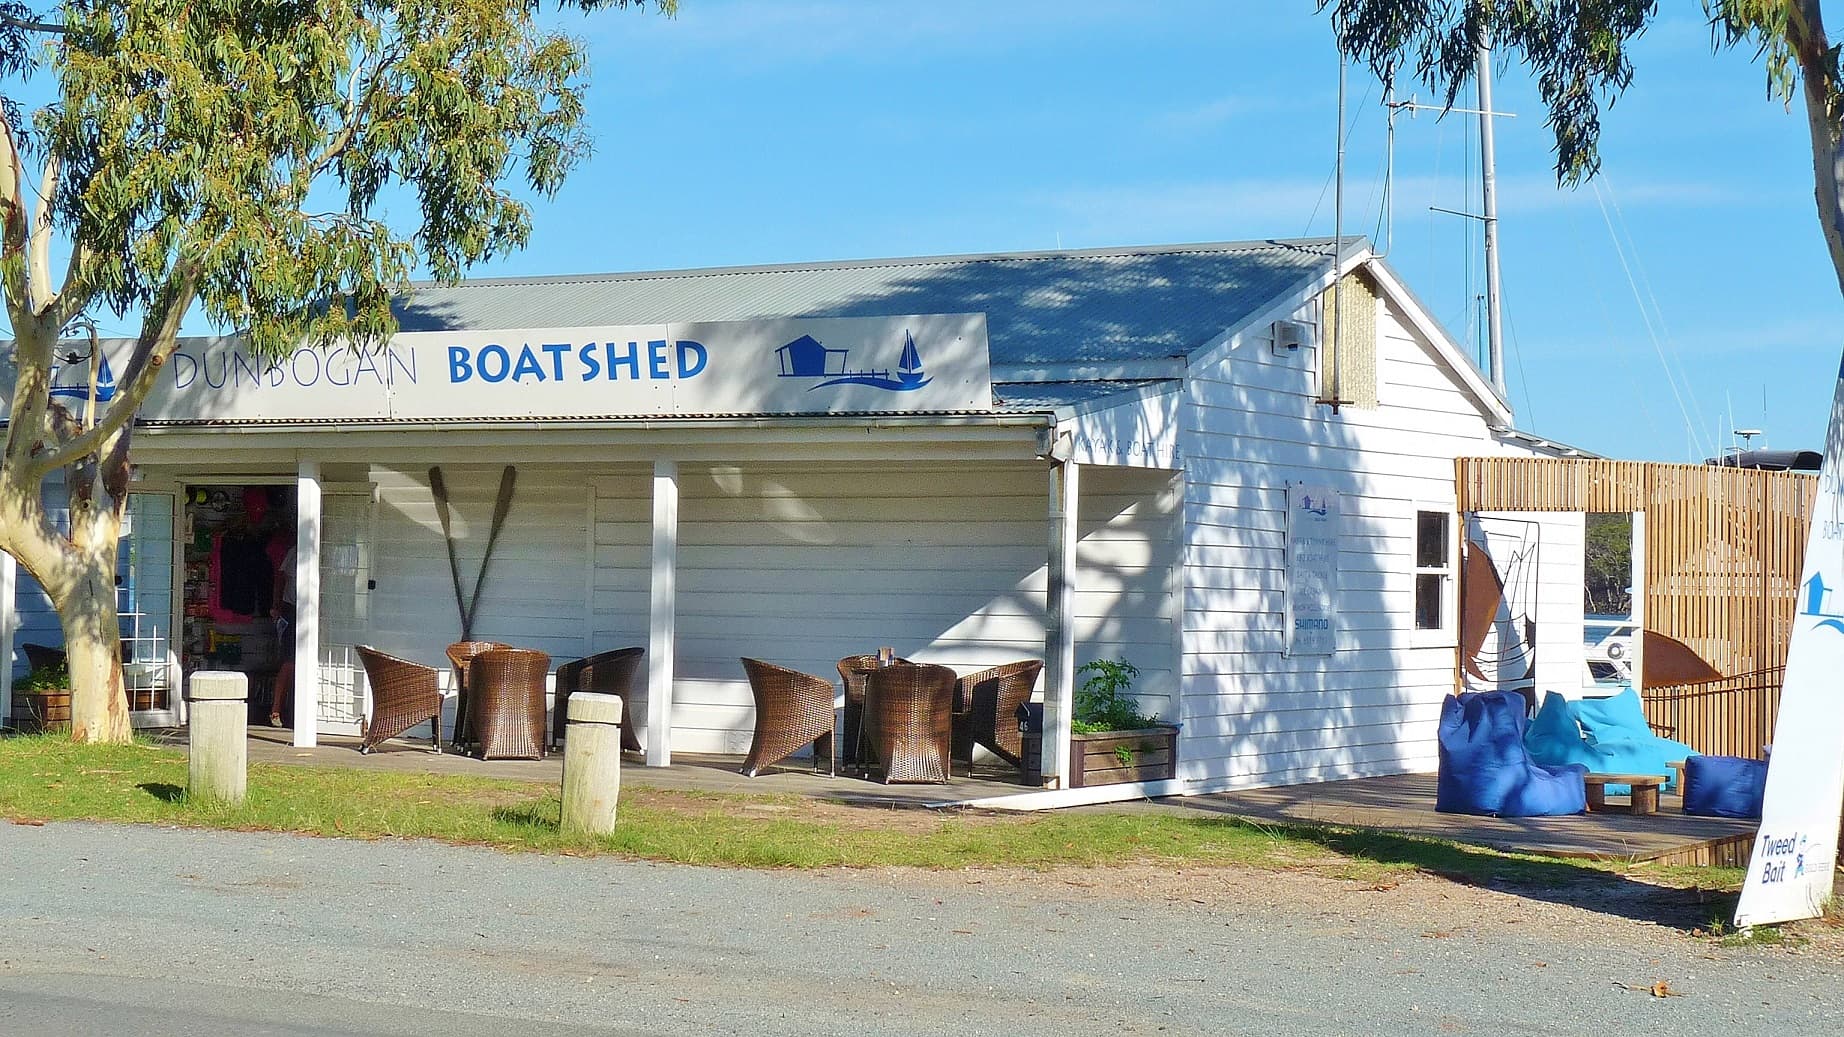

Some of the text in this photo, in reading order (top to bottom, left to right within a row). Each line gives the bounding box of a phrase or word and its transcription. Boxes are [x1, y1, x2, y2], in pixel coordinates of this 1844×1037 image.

[174, 340, 708, 390] DUNBOGAN BOATSHED
[1078, 437, 1113, 454] KAYAK
[1116, 439, 1123, 455] &
[1127, 440, 1154, 457] BOAT
[1294, 618, 1329, 630] SHIMANO
[1761, 831, 1798, 857] Tweed
[1761, 860, 1786, 885] Bait
